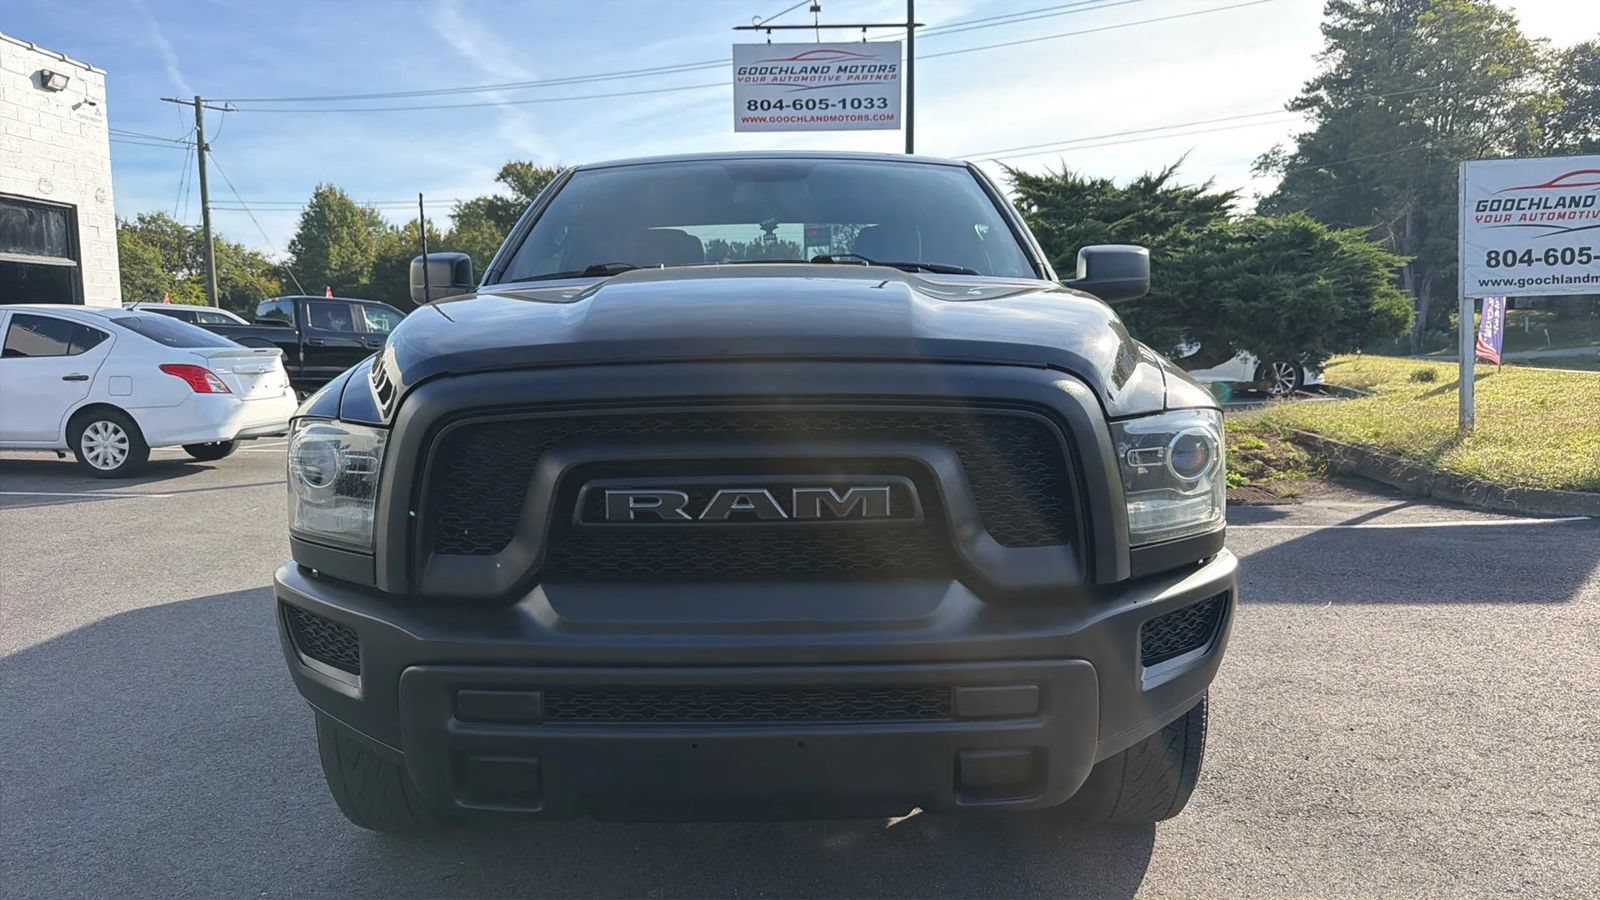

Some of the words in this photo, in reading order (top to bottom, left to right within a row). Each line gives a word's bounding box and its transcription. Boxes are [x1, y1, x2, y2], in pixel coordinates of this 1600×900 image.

[737, 64, 831, 76] GOOCHLAND
[836, 63, 898, 74] MOTORS
[746, 97, 889, 111] 804-605-1033
[741, 114, 895, 124] WWW.GOOCHLANDMOTORS.COM
[1475, 195, 1597, 213] GOOCHLAND
[1475, 214, 1512, 223] YOUR
[604, 486, 891, 520] RAM
